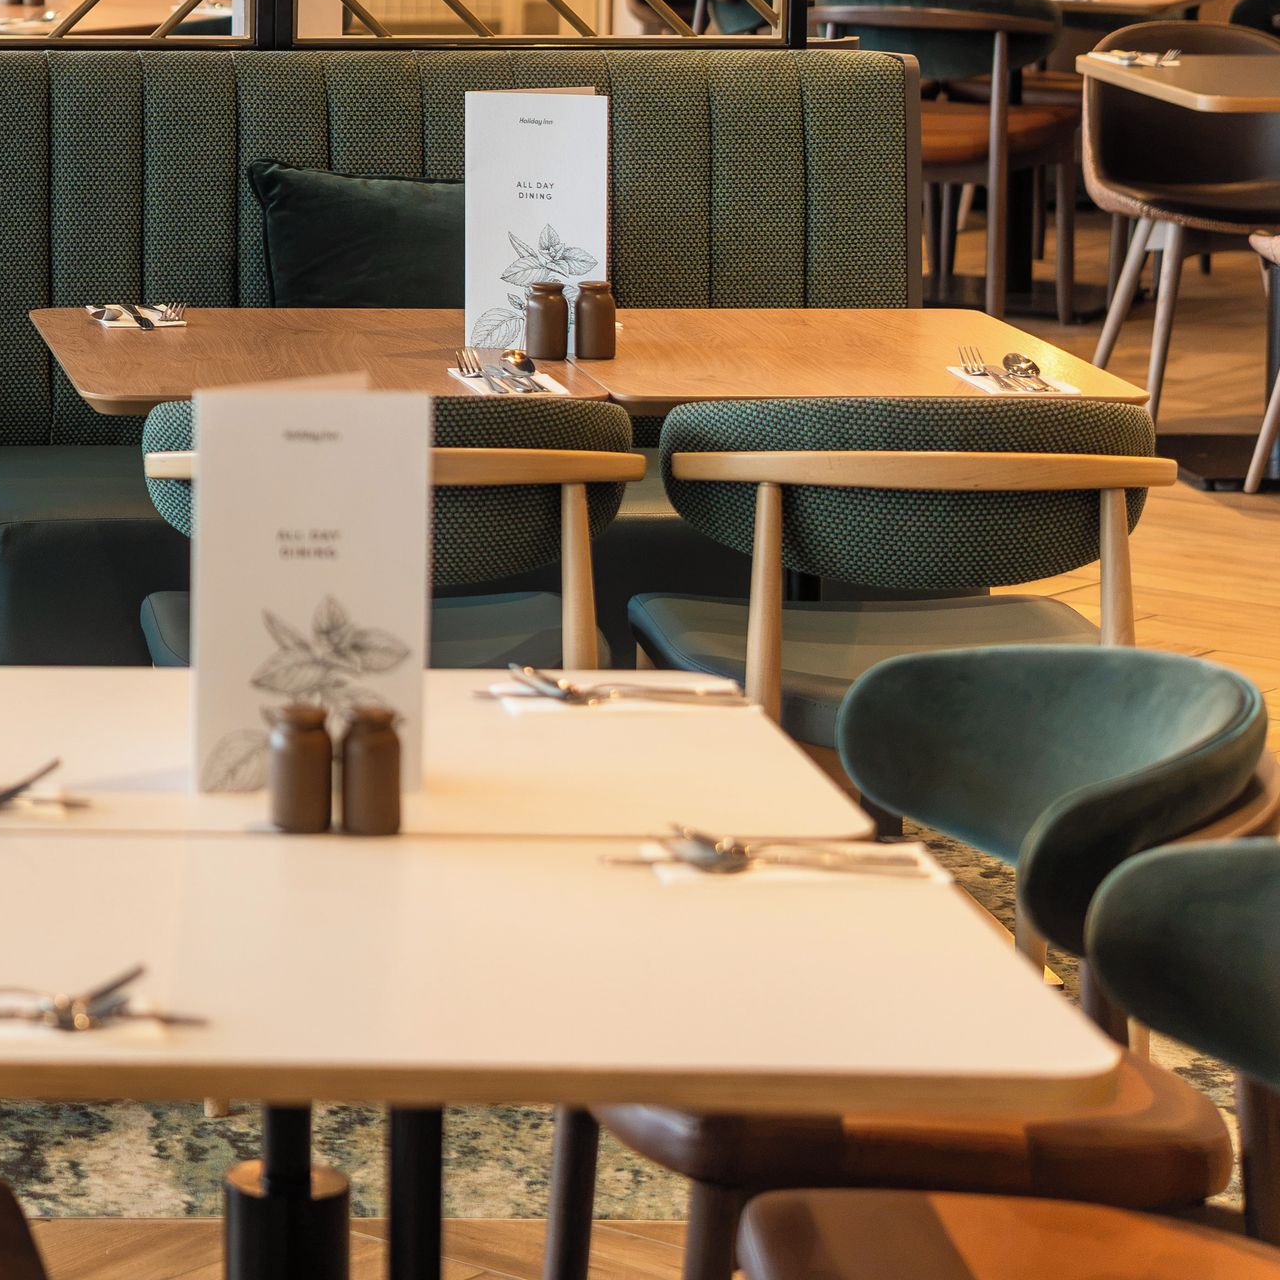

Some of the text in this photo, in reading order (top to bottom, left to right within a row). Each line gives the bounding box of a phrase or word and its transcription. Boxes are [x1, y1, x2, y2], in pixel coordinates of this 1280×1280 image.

[518, 117, 554, 126] Holiday Inn
[515, 181, 554, 190] ALL DAY
[518, 191, 553, 201] DINING
